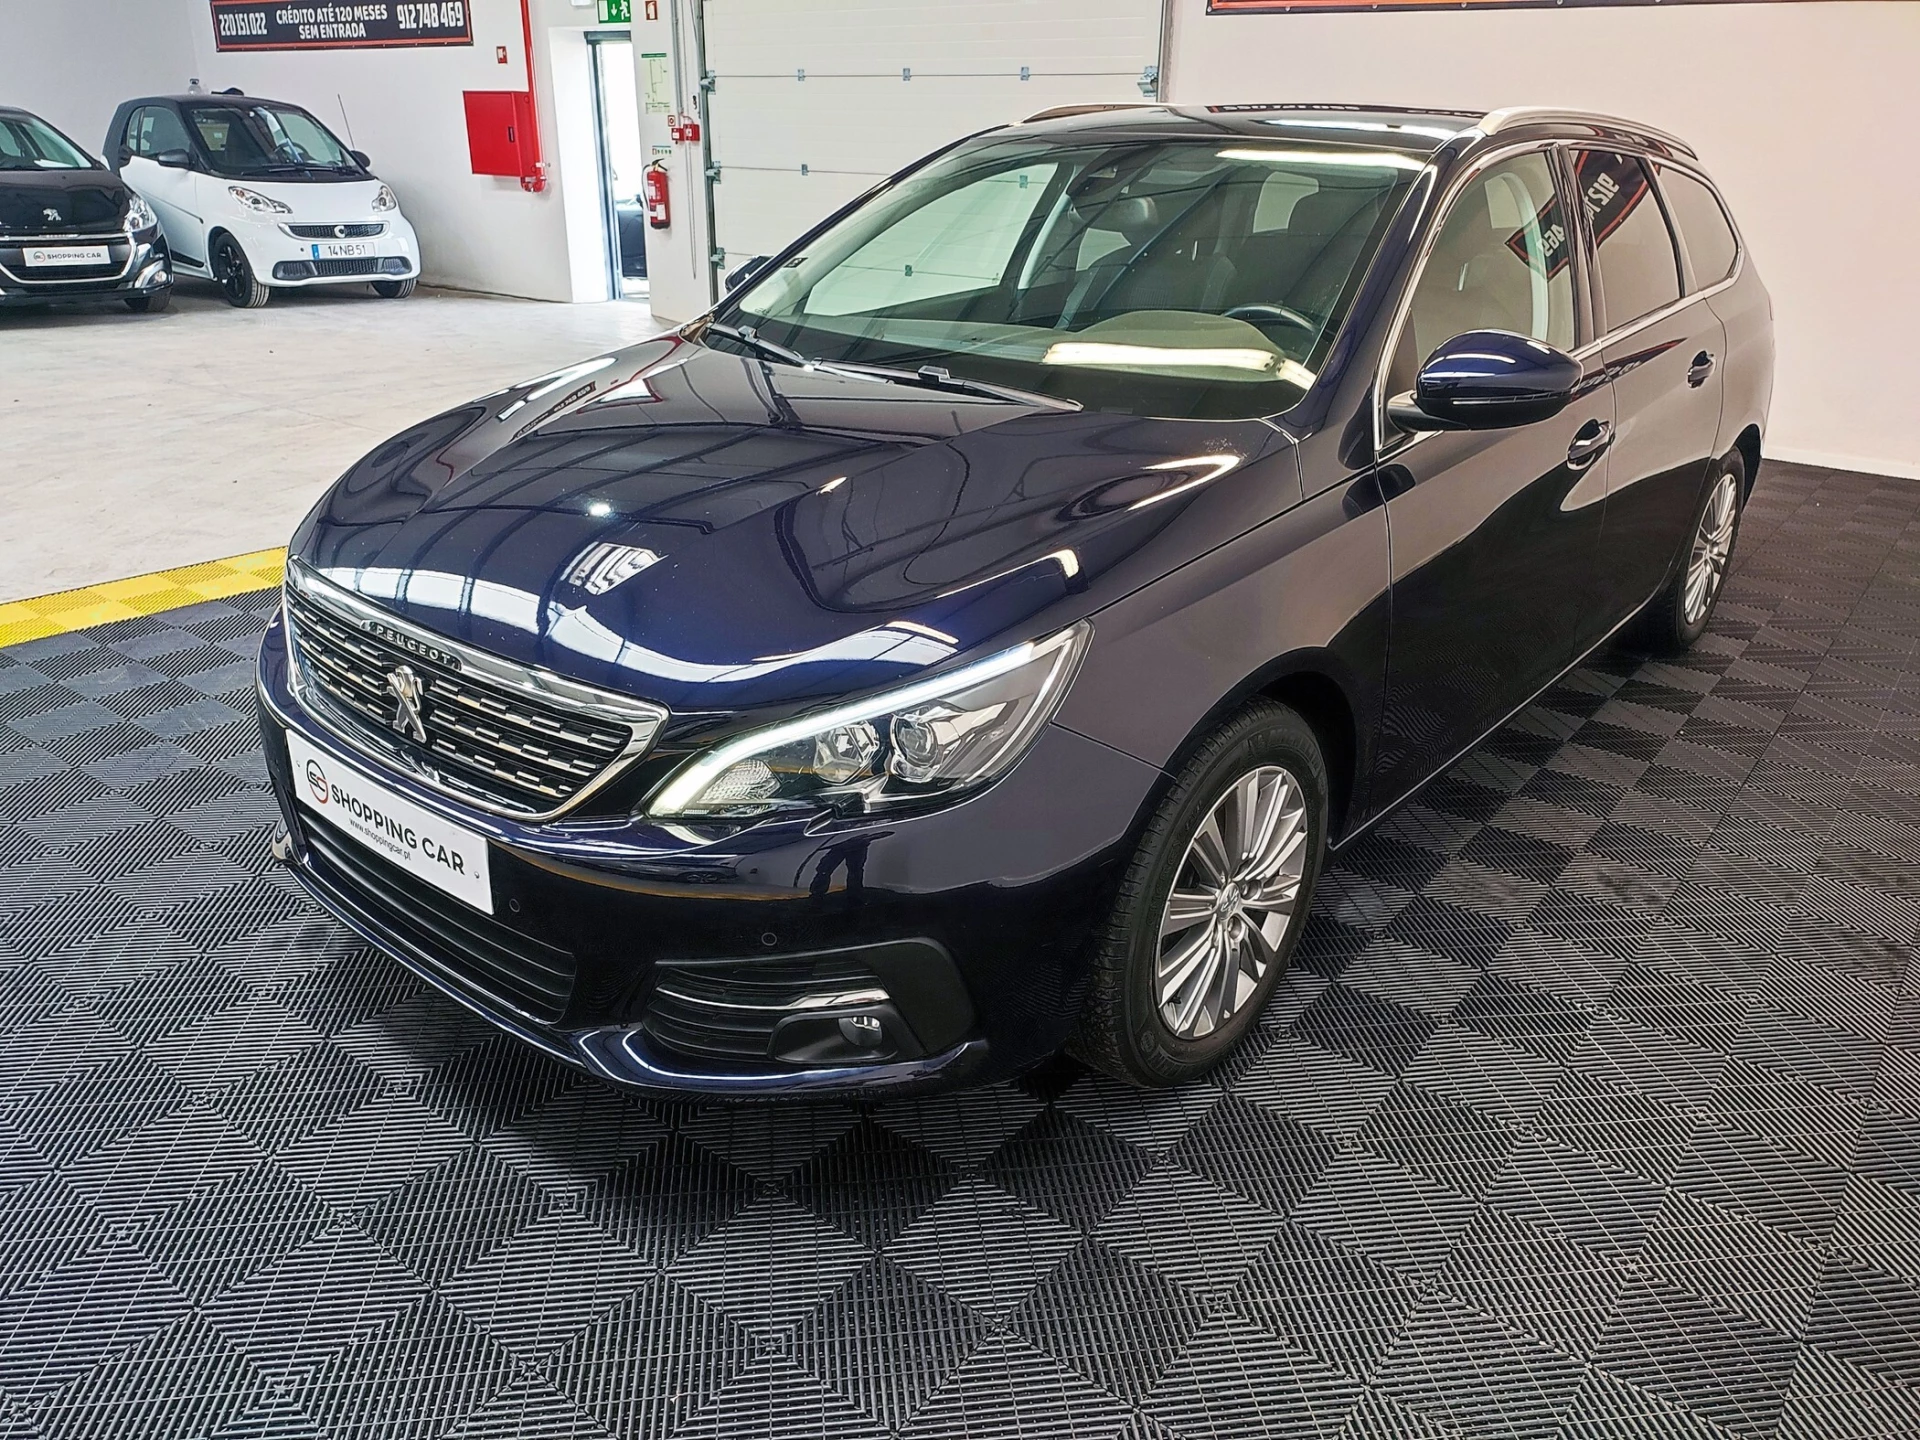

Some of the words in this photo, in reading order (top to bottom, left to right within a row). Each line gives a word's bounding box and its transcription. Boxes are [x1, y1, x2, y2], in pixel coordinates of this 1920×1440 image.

[276, 5, 315, 24] CRÉDITO
[317, 3, 335, 23] ATÉ
[335, 6, 353, 22] 120
[353, 4, 388, 21] MESES
[440, 1, 464, 27] 469
[298, 24, 319, 39] SEM
[320, 23, 366, 39] ENTRADA
[376, 625, 450, 664] PEUGEOT
[331, 784, 418, 849] SHOPPING
[422, 838, 465, 875] CAR
[348, 817, 411, 860] www.shoppingcar.pt
